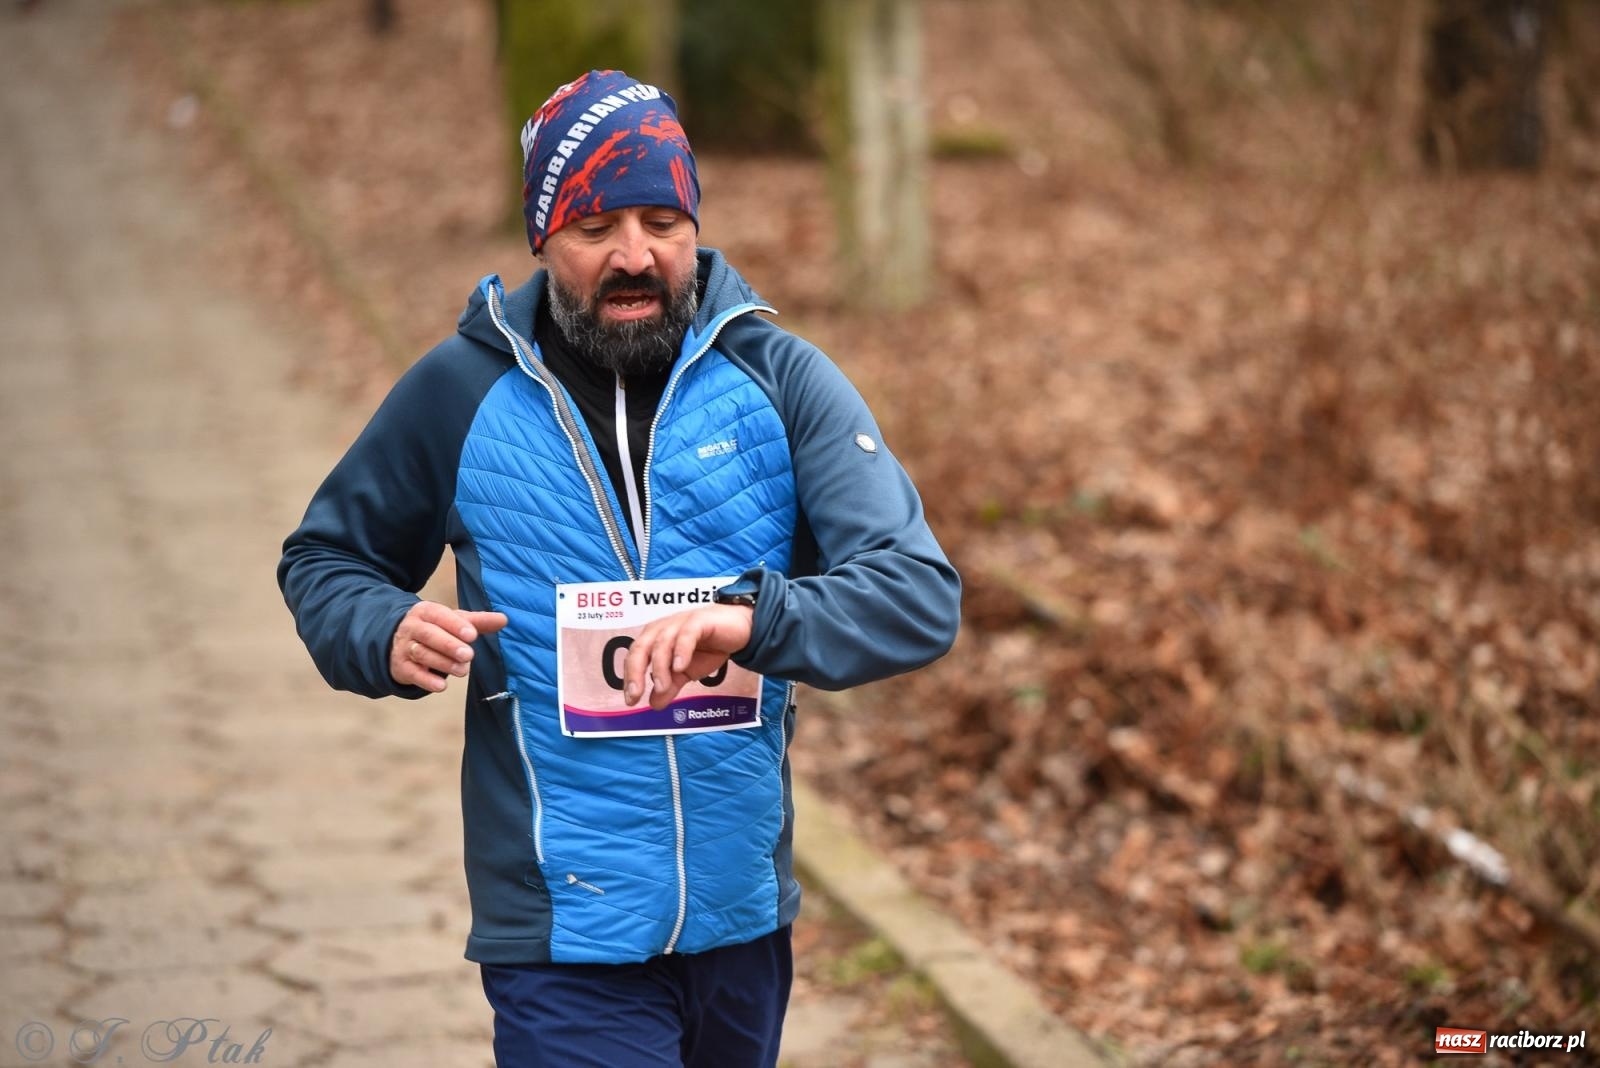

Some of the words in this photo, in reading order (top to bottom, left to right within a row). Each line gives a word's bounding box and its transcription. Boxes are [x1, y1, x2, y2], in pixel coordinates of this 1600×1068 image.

[535, 94, 629, 230] BARBARIAN
[577, 591, 624, 608] BIEG
[577, 612, 587, 620] 23
[588, 611, 603, 621] luty
[605, 610, 624, 619] 2025
[687, 708, 730, 720] Racibórz
